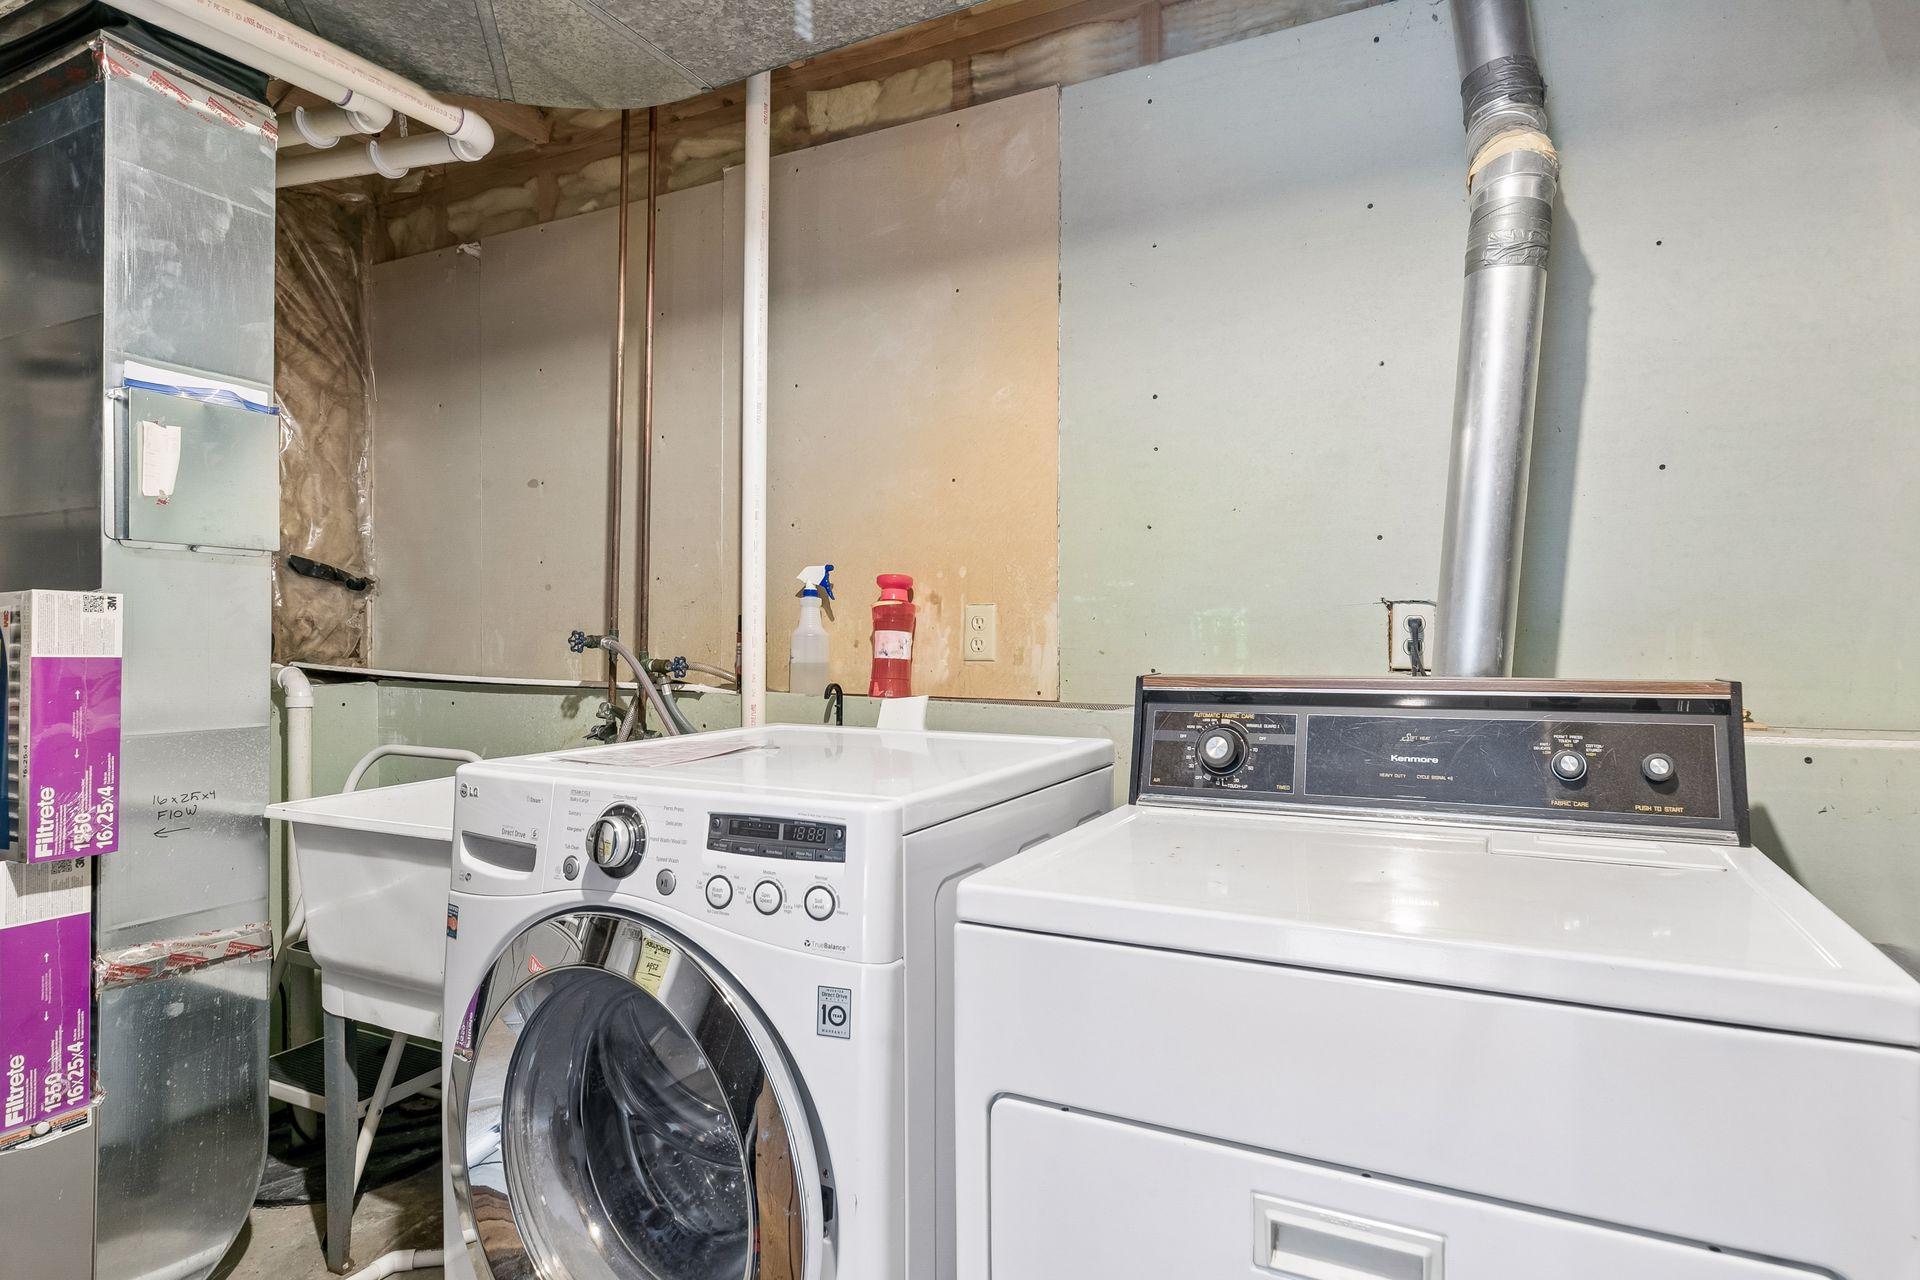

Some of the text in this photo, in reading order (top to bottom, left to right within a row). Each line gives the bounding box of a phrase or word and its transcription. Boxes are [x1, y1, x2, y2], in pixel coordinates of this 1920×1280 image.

[107, 596, 117, 611] 3M
[4, 610, 10, 628] 3M
[1390, 754, 1439, 763] Kenmore
[468, 786, 479, 798] LG
[35, 786, 55, 858] Filtrete
[96, 786, 114, 849] 16x25x4
[502, 828, 514, 836] Direct
[812, 941, 846, 951] TrueBalance
[822, 1004, 847, 1026] 10
[67, 1041, 84, 1106] 16x25x4
[5, 1054, 24, 1128] Filtrete
[44, 1072, 62, 1113] 1550
